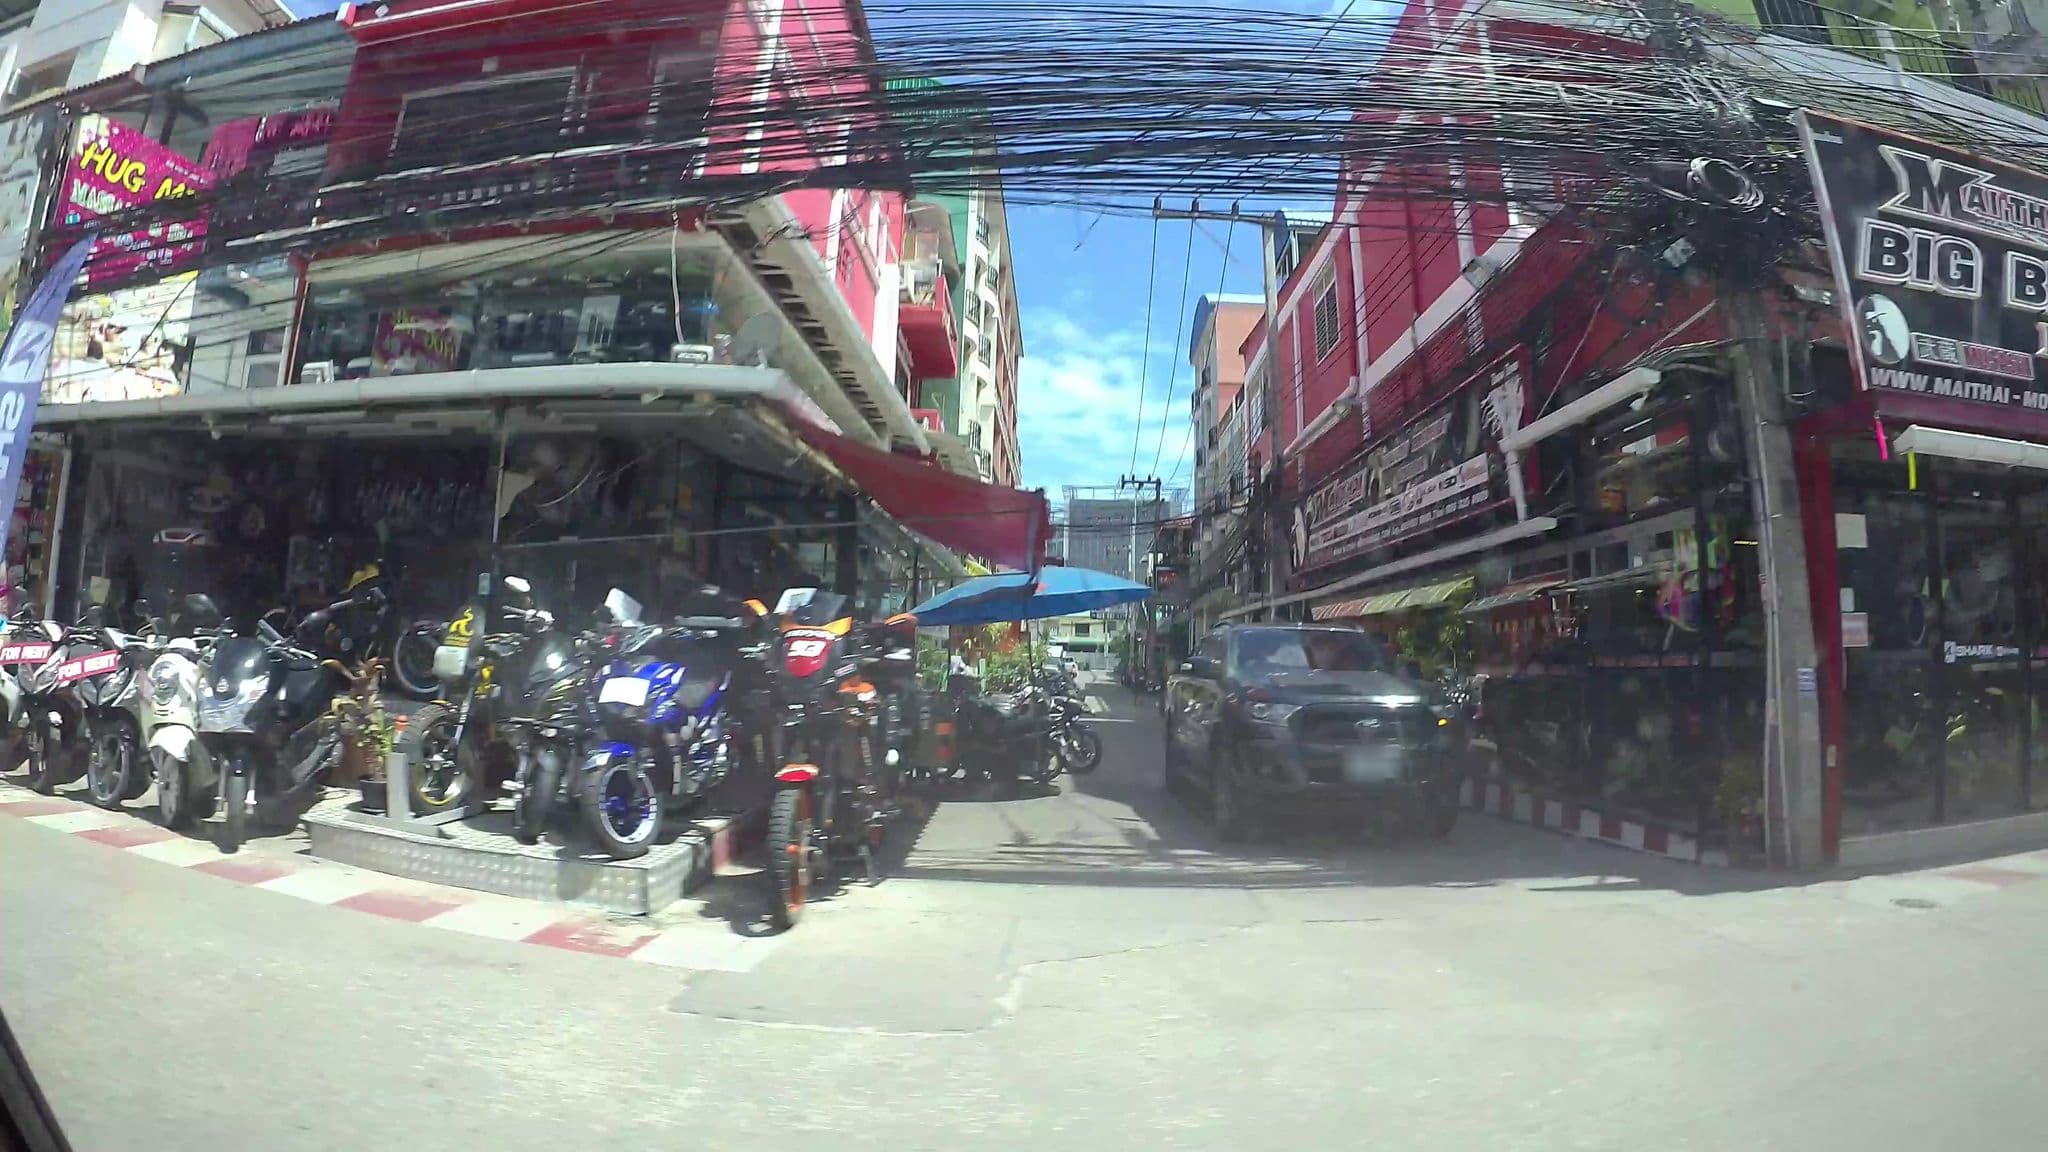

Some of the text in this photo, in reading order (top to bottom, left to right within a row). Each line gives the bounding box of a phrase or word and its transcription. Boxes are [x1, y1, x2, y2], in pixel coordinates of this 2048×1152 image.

[80, 142, 146, 193] HUG
[1855, 217, 1984, 298] BIG
[0, 645, 52, 661] FOR RENT
[59, 653, 117, 680] FOR RENT
